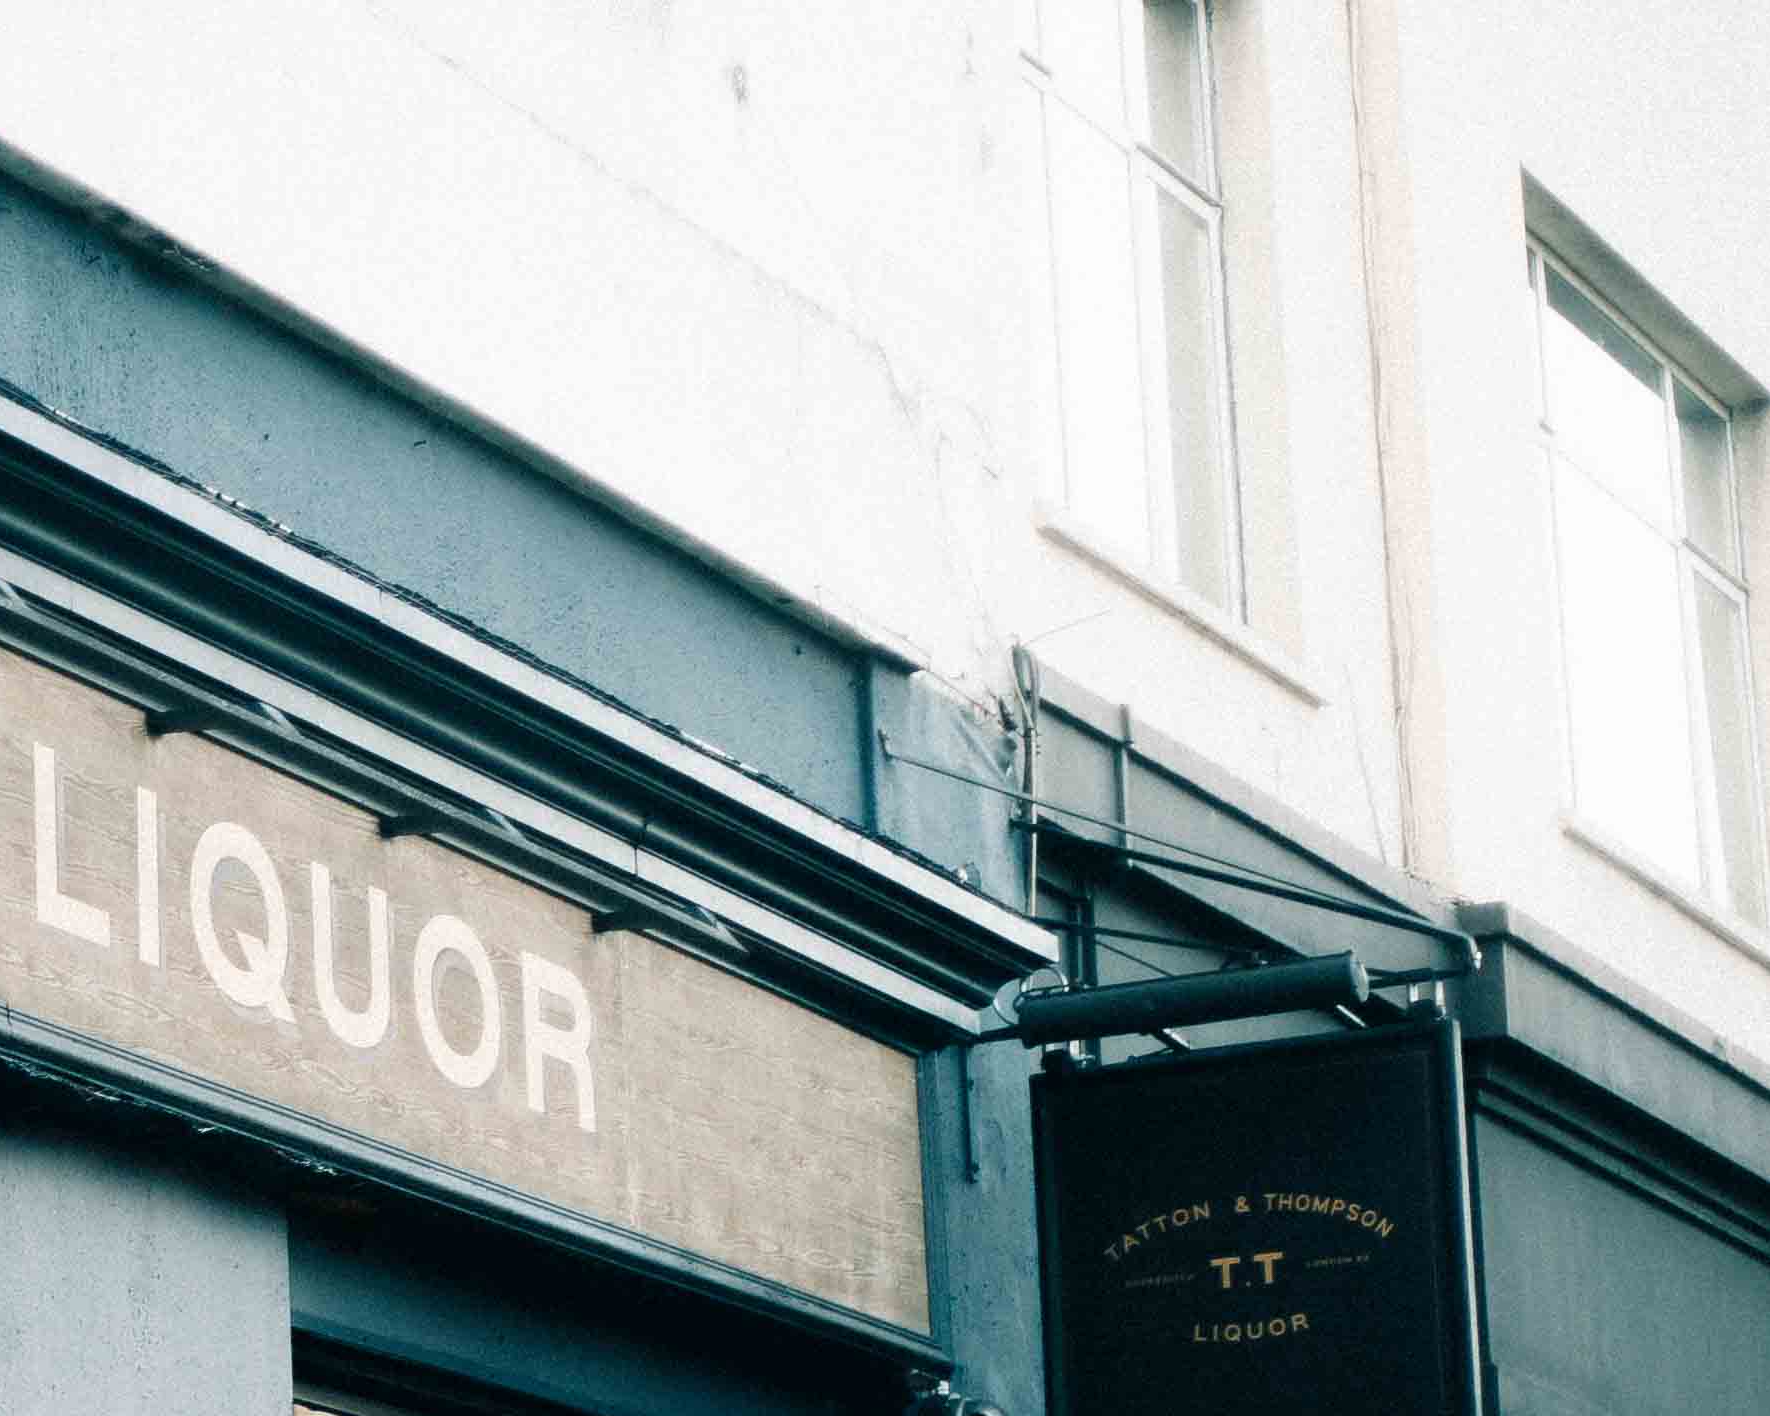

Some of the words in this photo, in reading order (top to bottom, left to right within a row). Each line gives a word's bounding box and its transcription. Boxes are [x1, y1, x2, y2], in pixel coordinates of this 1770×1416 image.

[34, 741, 595, 1133] LIQUOR
[1104, 1200, 1211, 1260] TATTON
[1234, 1195, 1250, 1213] &
[1263, 1193, 1394, 1239] THOMPSON
[1193, 1312, 1310, 1343] LIQUOR
